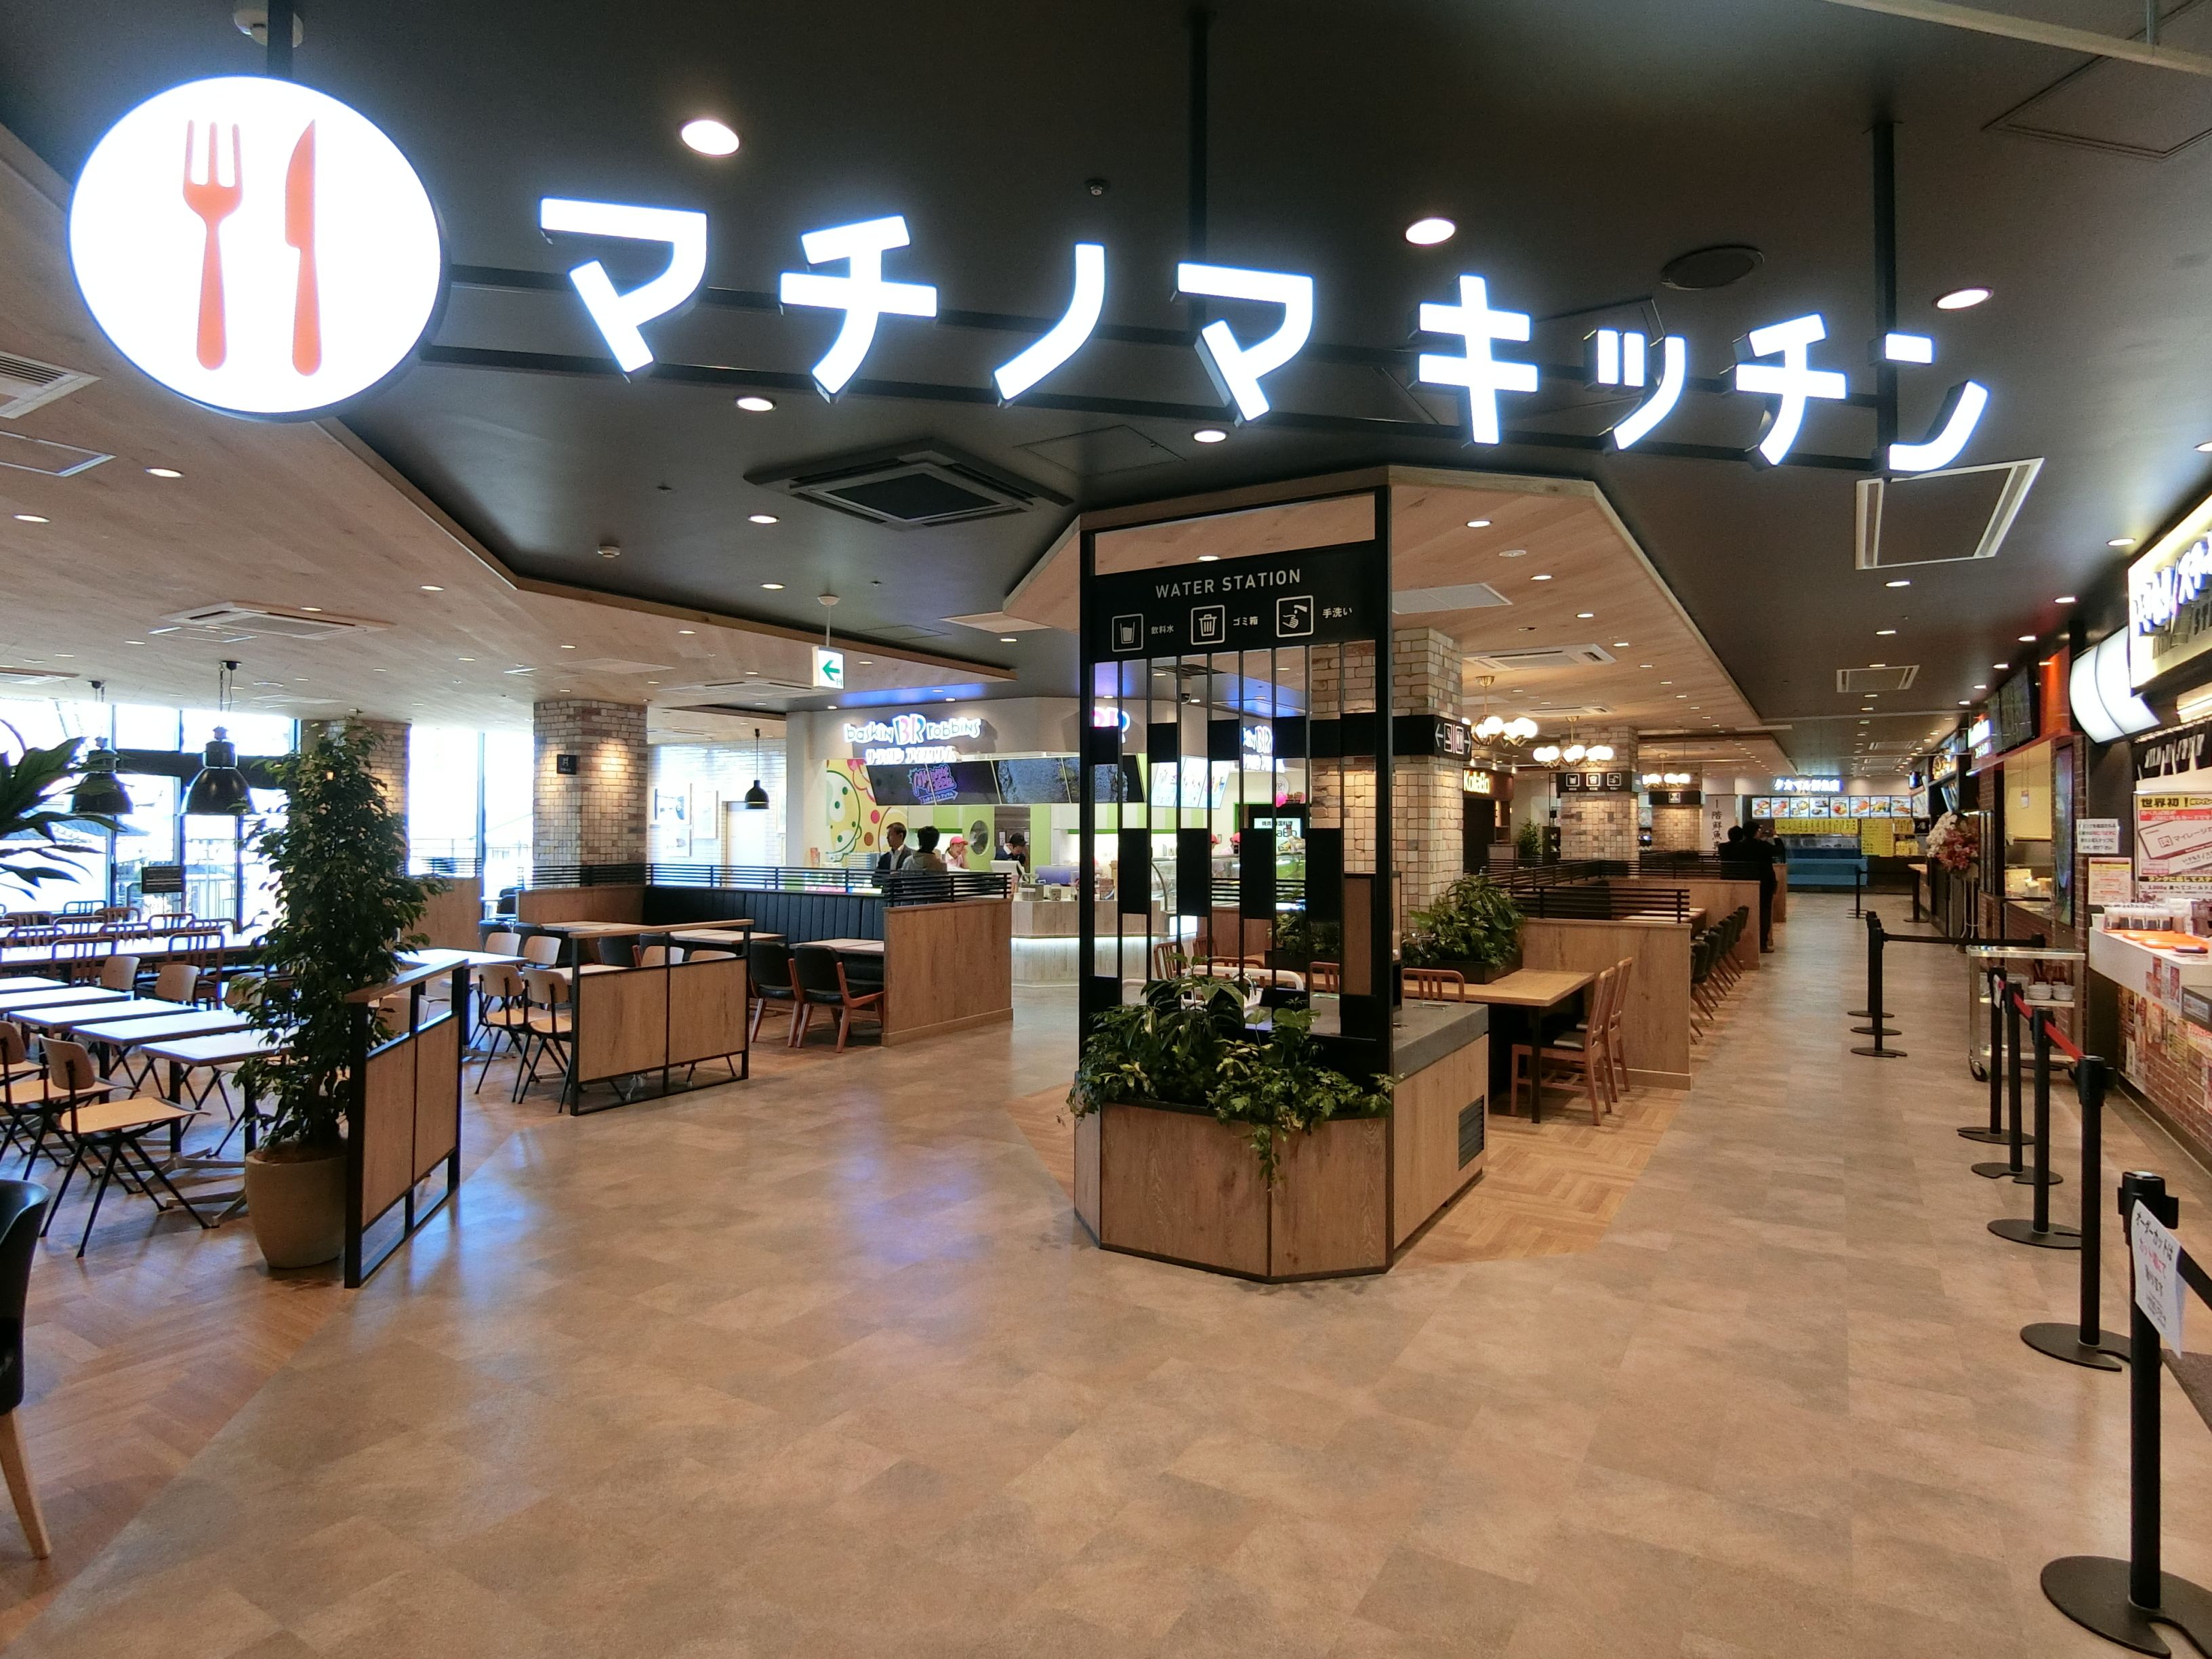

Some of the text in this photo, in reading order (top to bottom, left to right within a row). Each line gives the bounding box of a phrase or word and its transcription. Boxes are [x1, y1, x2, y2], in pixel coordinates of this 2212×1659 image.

[540, 197, 1989, 473] マチノマキッチン
[1155, 569, 1301, 598] WATER STATION
[1233, 616, 1258, 626] ゴミ箱
[1322, 607, 1353, 619] 手洗い
[1151, 624, 1174, 635] 飲料水
[844, 714, 982, 745] baskin BR robbins
